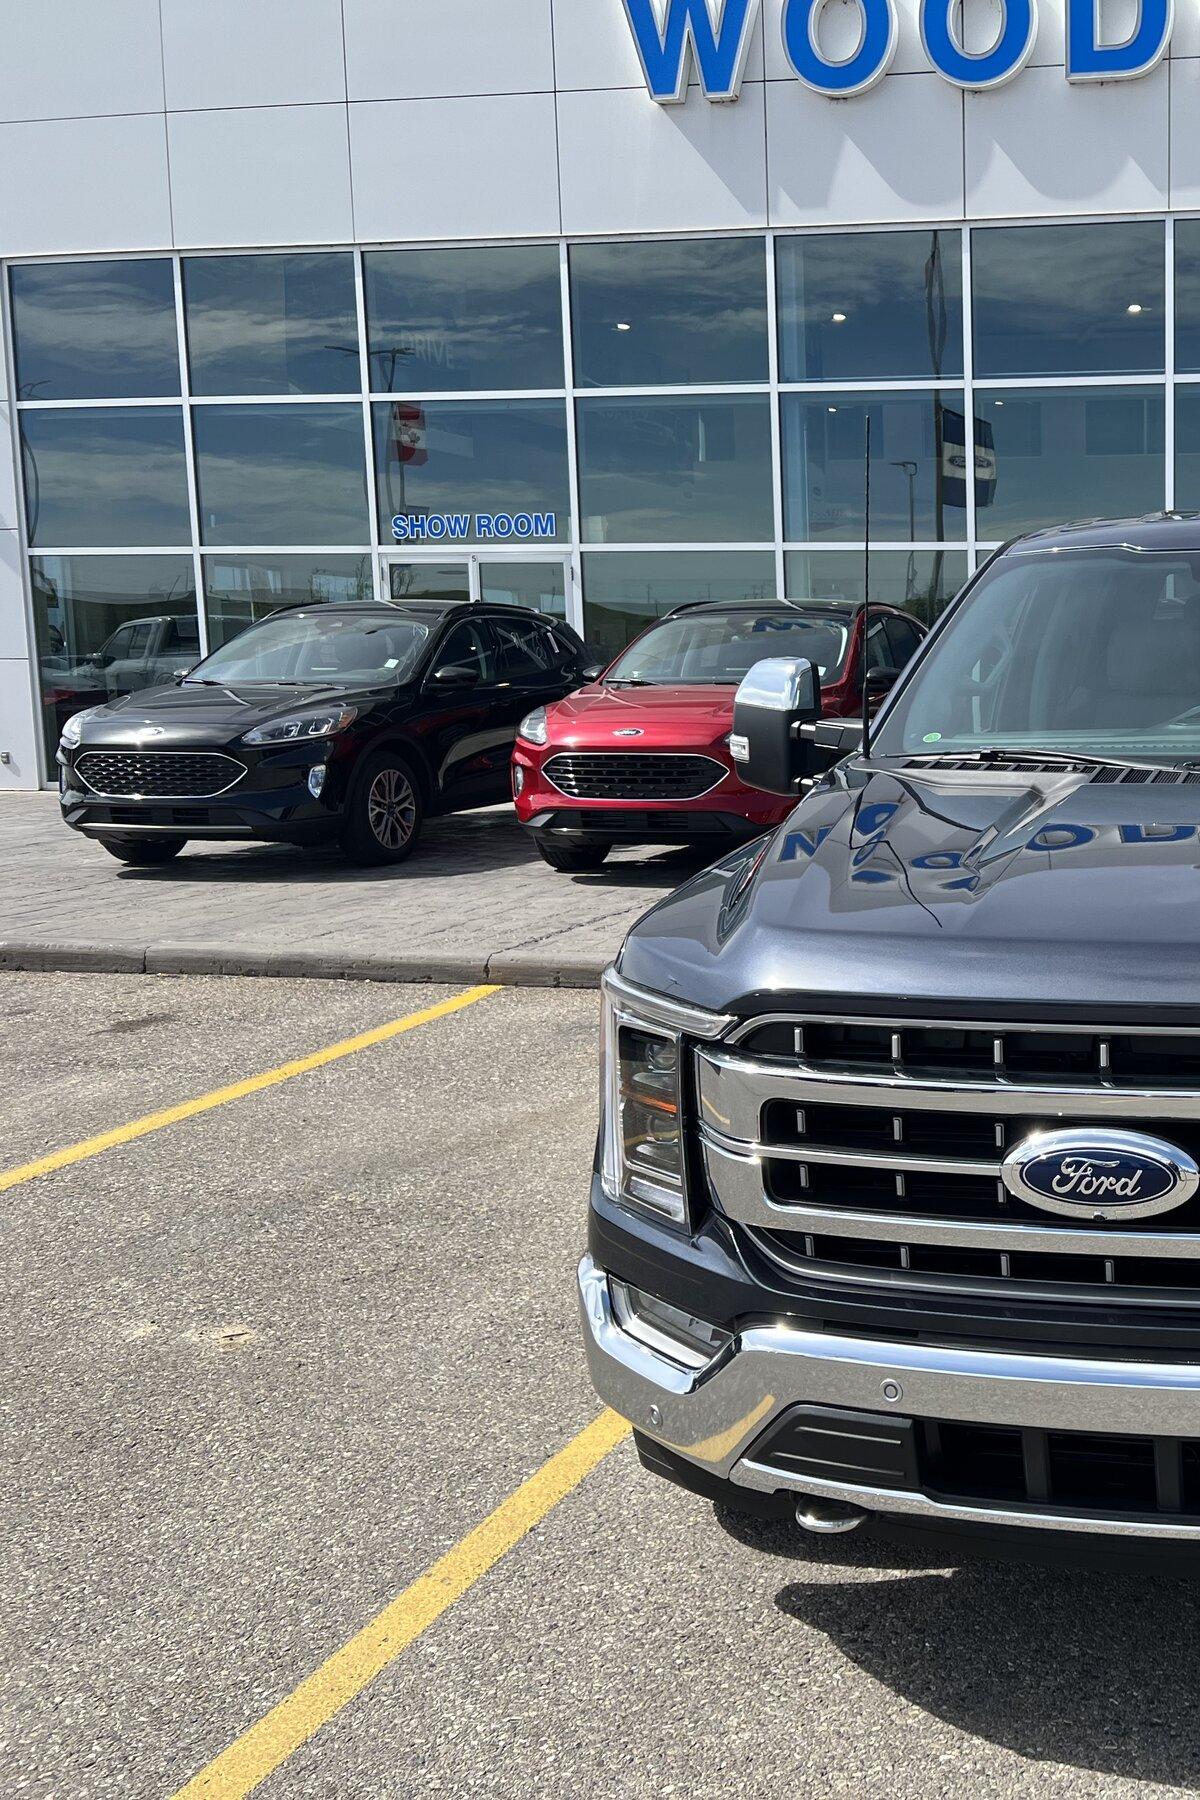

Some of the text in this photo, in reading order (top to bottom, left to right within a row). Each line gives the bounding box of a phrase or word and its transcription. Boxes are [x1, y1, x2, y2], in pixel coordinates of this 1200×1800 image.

[392, 512, 556, 539] SHOW ROOM
[1052, 1157, 1143, 1196] Ford
